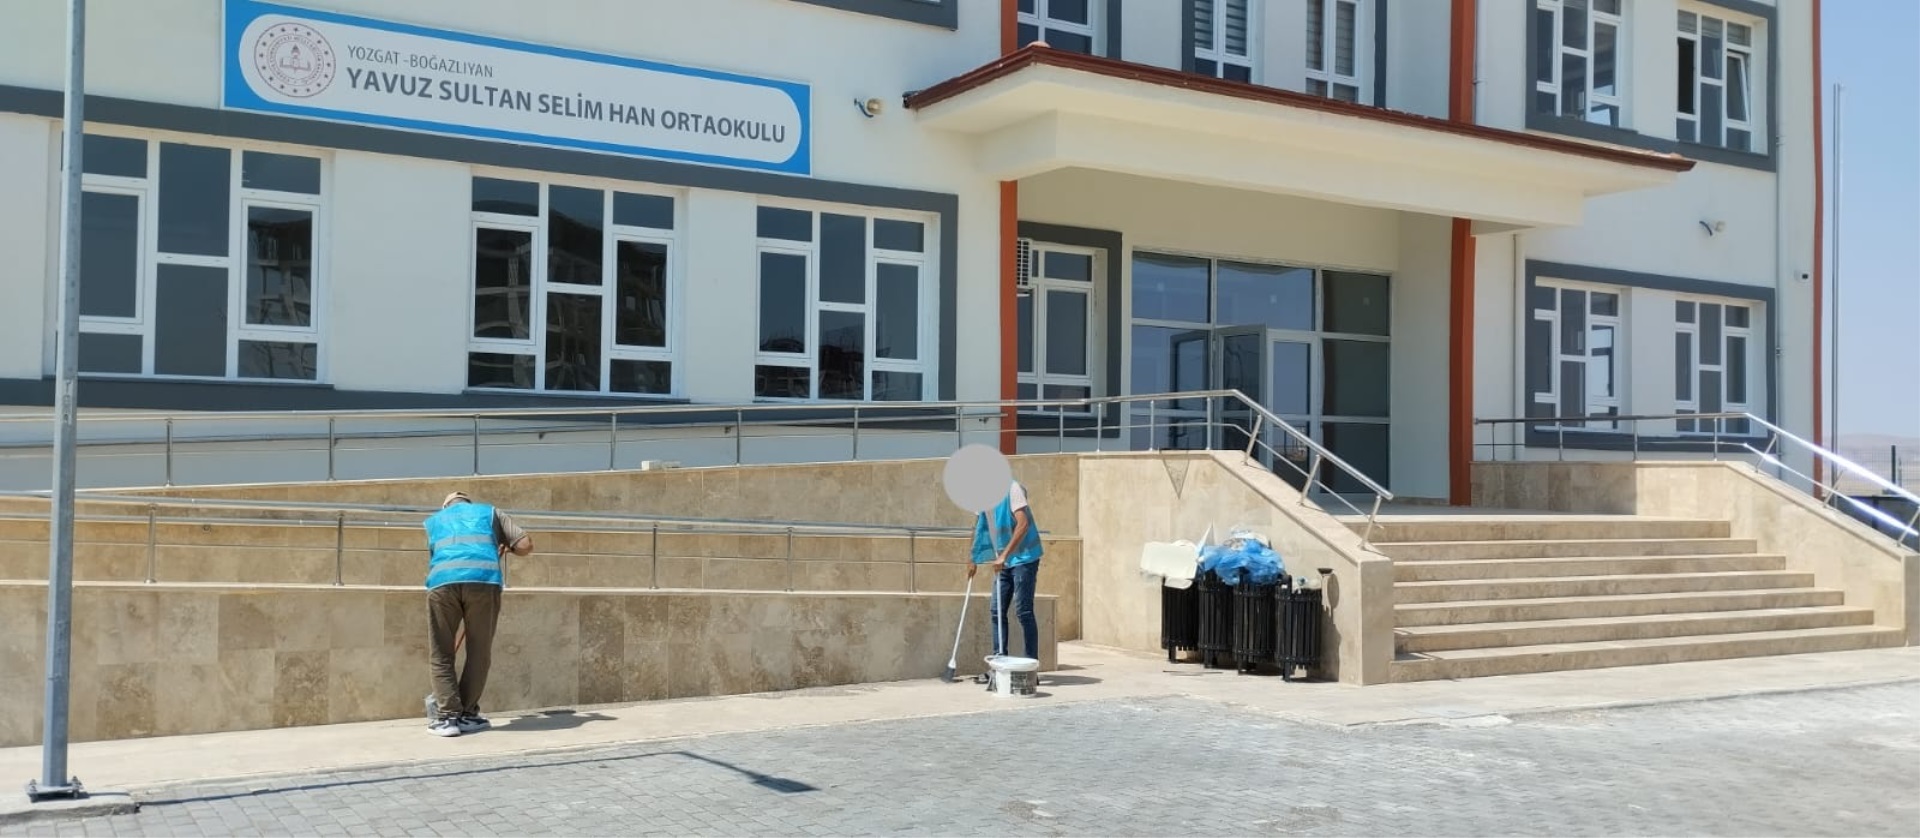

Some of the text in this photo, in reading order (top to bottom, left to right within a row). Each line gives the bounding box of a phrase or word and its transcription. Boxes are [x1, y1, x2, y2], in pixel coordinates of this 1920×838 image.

[347, 45, 400, 65] YOZGAT
[346, 66, 786, 144] YAVUZ SULTAN SELİM HAN ORTAOKULU
